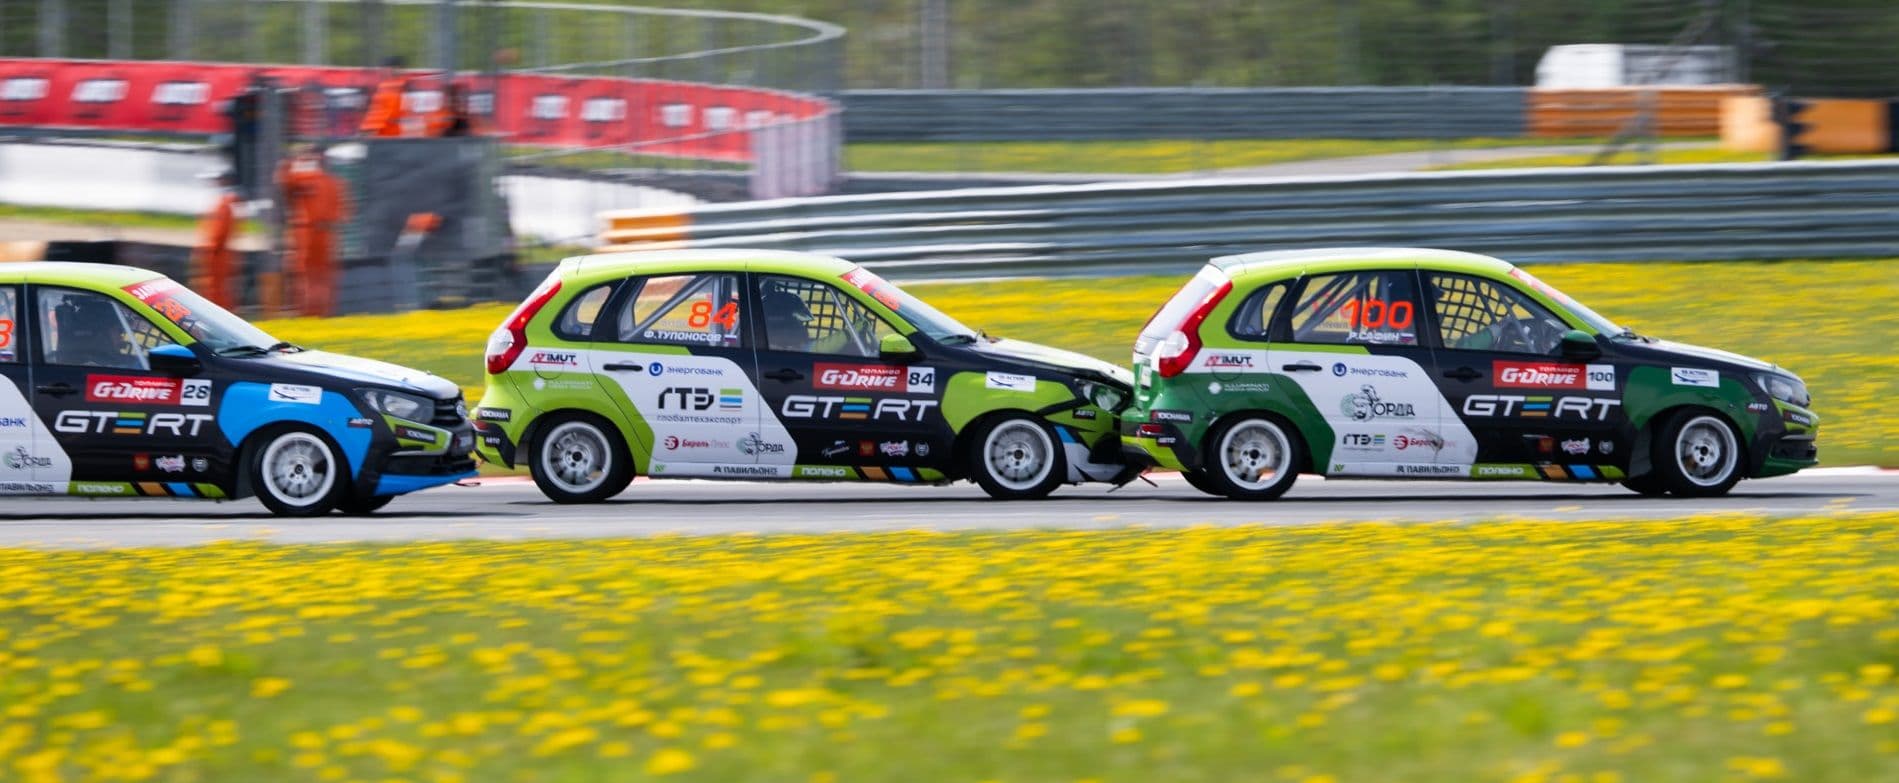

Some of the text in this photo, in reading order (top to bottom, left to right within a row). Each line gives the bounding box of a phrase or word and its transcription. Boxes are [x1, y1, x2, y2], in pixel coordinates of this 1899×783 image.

[688, 301, 737, 331] 84
[1344, 300, 1413, 330] 100
[667, 366, 724, 376] энергобанк
[1350, 367, 1407, 378] энергобанк
[1588, 372, 1614, 382] 100
[908, 372, 933, 386] 84
[183, 385, 210, 399] 28
[658, 387, 714, 411] ГТЭ
[657, 415, 742, 424] глобалтехэкспорт
[1343, 434, 1371, 445] ГТЭ
